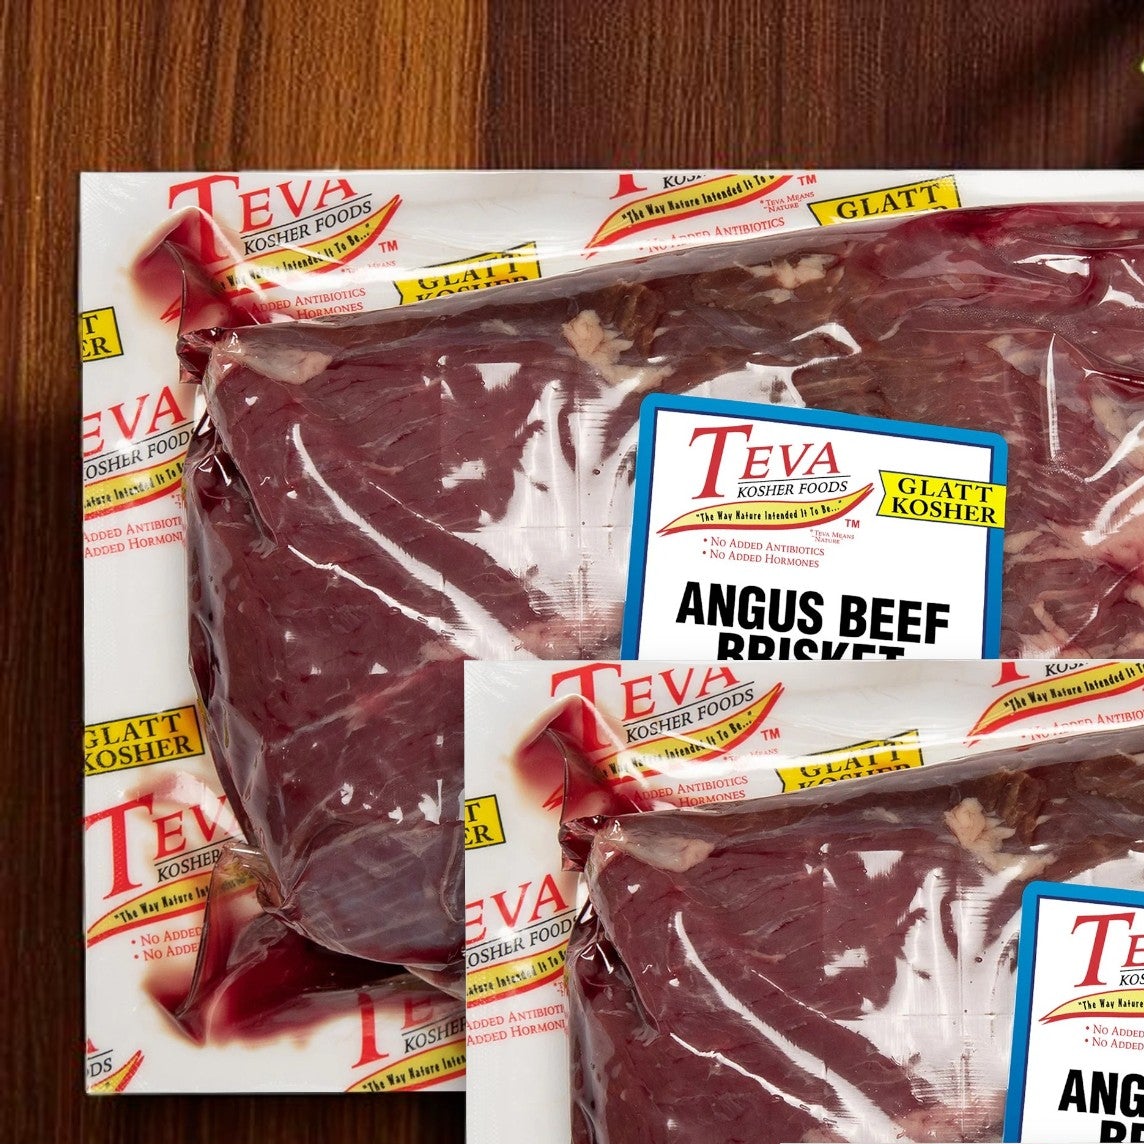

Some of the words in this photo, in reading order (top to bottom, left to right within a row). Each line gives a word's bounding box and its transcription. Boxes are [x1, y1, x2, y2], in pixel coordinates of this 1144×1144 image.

[667, 195, 699, 211] Nature
[701, 182, 741, 204] Intended
[836, 182, 941, 219] GLATT
[243, 225, 311, 256] KOSHER
[315, 200, 372, 233] FOODS
[378, 239, 399, 253] TM
[688, 424, 840, 499] TEVA
[737, 484, 793, 499] KOSHER
[797, 481, 848, 495] FOODS
[898, 477, 994, 503] GLATT
[717, 510, 732, 521] Way
[735, 510, 761, 520] Nature
[764, 507, 798, 520] Intended
[891, 496, 996, 525] KOSHER
[844, 518, 860, 528] TM
[729, 538, 762, 550] ADDED
[766, 542, 825, 556] ANTIBIOTICS
[728, 551, 762, 563] ADDED
[765, 554, 819, 568] HORMONES
[675, 581, 824, 634] ANGUS
[839, 594, 950, 645] BEEF
[1050, 683, 1082, 699] Nature
[1084, 670, 1124, 692] Intended
[626, 713, 694, 744] KOSHER
[698, 688, 755, 721] FOODS
[761, 727, 782, 741] TM
[157, 849, 220, 882] KOSHER
[1100, 998, 1115, 1009] Way
[1118, 998, 1144, 1008] Nature
[1112, 1026, 1144, 1038] ADDED
[1111, 1039, 1144, 1051] ADDED
